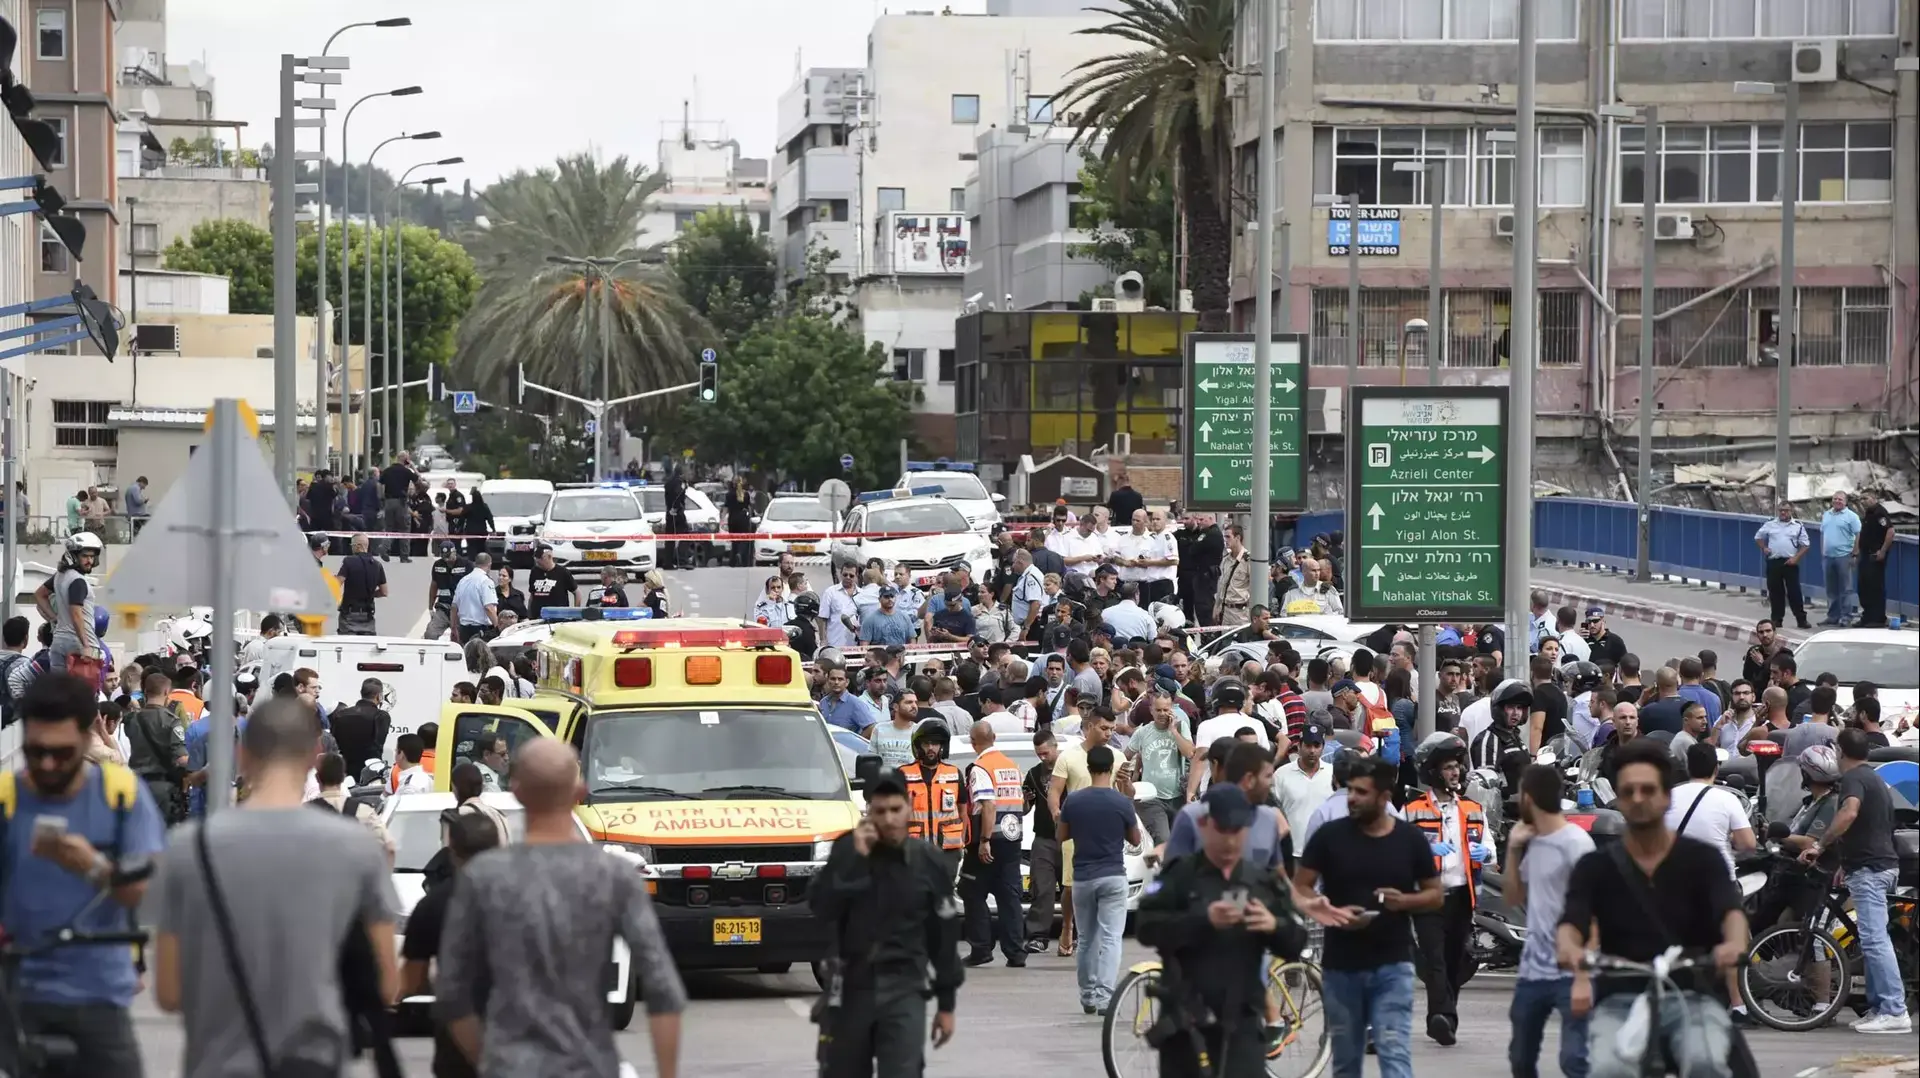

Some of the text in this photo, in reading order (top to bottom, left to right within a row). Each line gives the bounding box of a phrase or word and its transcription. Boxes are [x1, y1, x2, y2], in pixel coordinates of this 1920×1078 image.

[1336, 223, 1393, 232] משרים
[1212, 365, 1233, 377] אלון
[1237, 365, 1255, 375] גאל
[1215, 395, 1238, 406] Yigal
[1212, 413, 1239, 423] יצחק
[1386, 428, 1478, 442] מרכז עזריאלי
[1210, 442, 1244, 451] Nahalat
[1282, 442, 1295, 450] St.
[1390, 468, 1474, 480] Azrieli Center
[1392, 489, 1419, 506] אלון
[1424, 489, 1453, 503] יגאל
[1450, 510, 1472, 521] شارع
[1396, 529, 1480, 543] Yigal Alon St.
[1383, 553, 1419, 566] יצחק
[1424, 550, 1461, 563] נחלת
[1453, 571, 1478, 582] طريق
[1382, 590, 1493, 601] Nahalat Yitshak St.
[390, 724, 409, 733] חבל
[648, 806, 809, 819] מגן דוד אדום
[606, 812, 638, 829] 20
[652, 816, 812, 832] AMBULANCE
